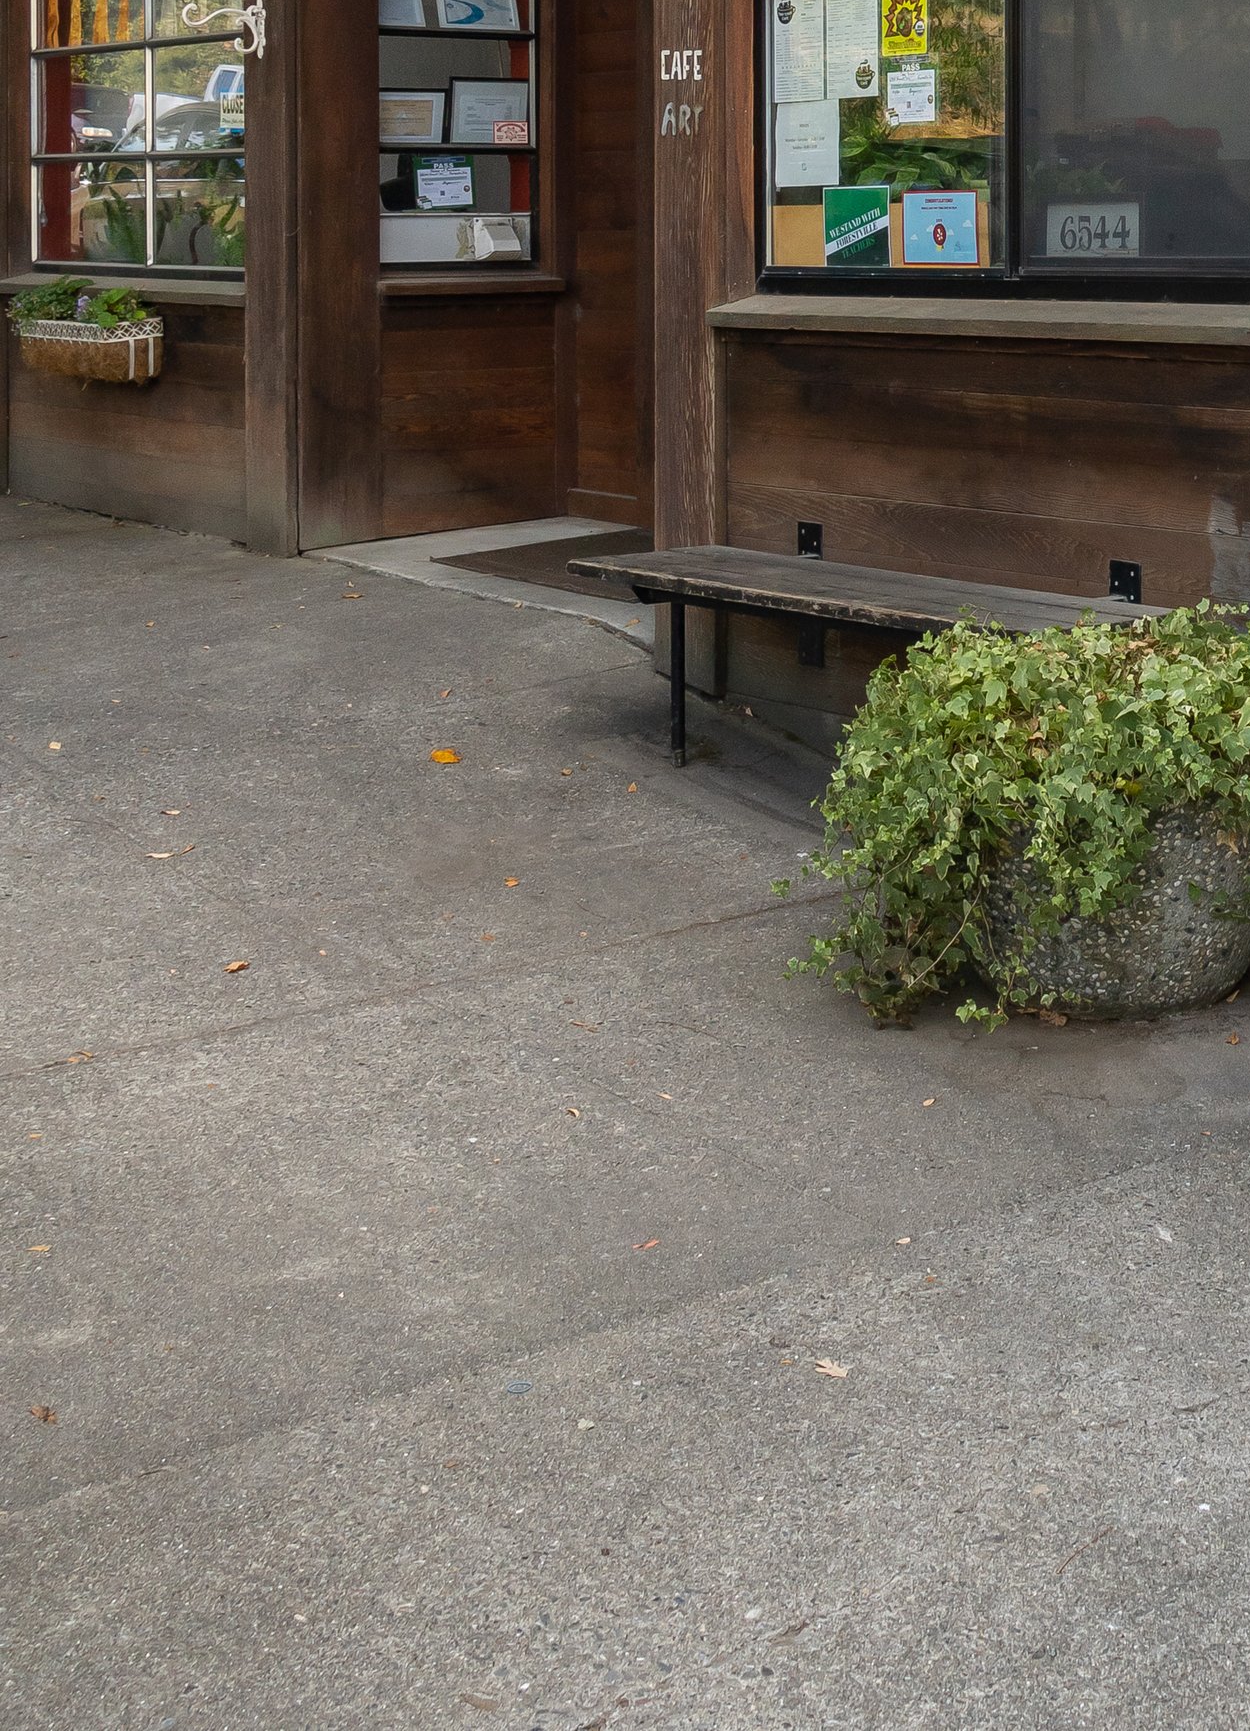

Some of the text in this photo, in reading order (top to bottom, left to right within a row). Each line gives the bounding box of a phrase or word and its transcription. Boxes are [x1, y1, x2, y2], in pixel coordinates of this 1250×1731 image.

[661, 49, 703, 81] CAFE
[902, 62, 921, 72] PASS
[661, 101, 704, 137] ART
[433, 162, 455, 170] PASS
[1060, 215, 1131, 252] 6544
